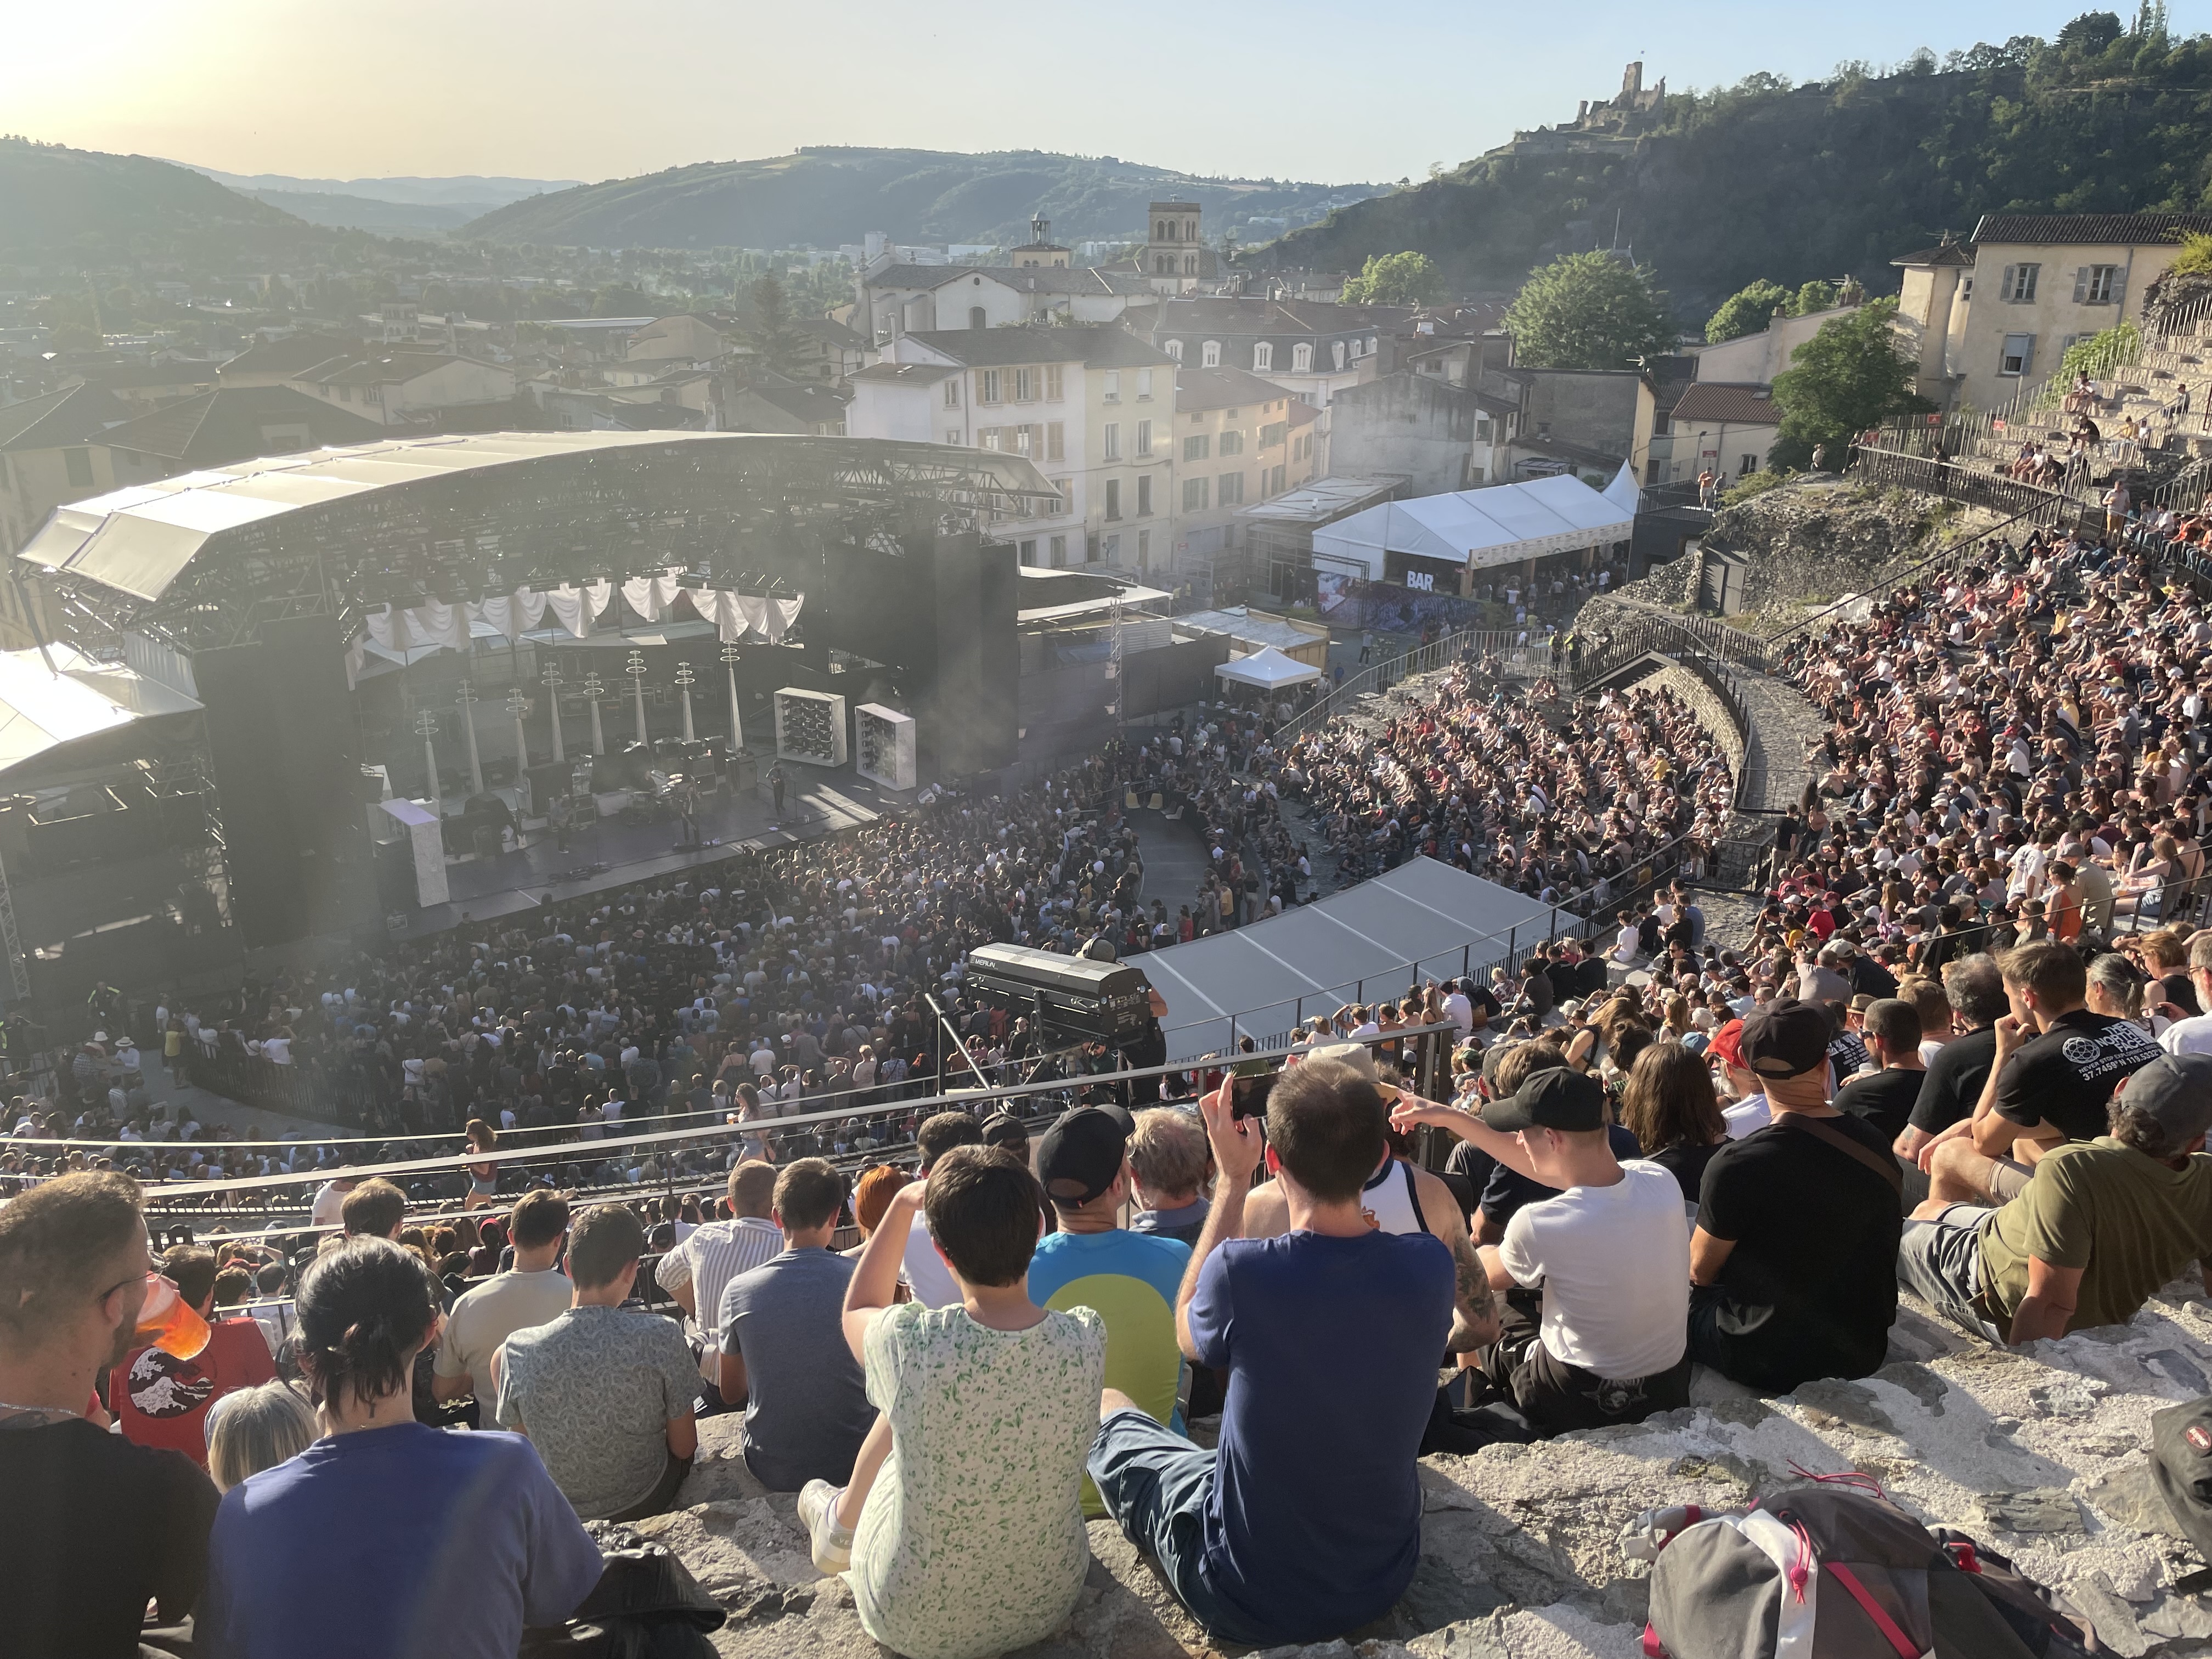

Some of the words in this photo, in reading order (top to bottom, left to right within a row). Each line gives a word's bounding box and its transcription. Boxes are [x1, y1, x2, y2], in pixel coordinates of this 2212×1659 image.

[1407, 571, 1434, 592] BAR
[2095, 1029, 2140, 1047] NORTH
[2101, 1023, 2128, 1035] THE
[2114, 1037, 2146, 1053] FACE
[2078, 1062, 2100, 1074] NEVER
[2100, 1056, 2114, 1064] STOP
